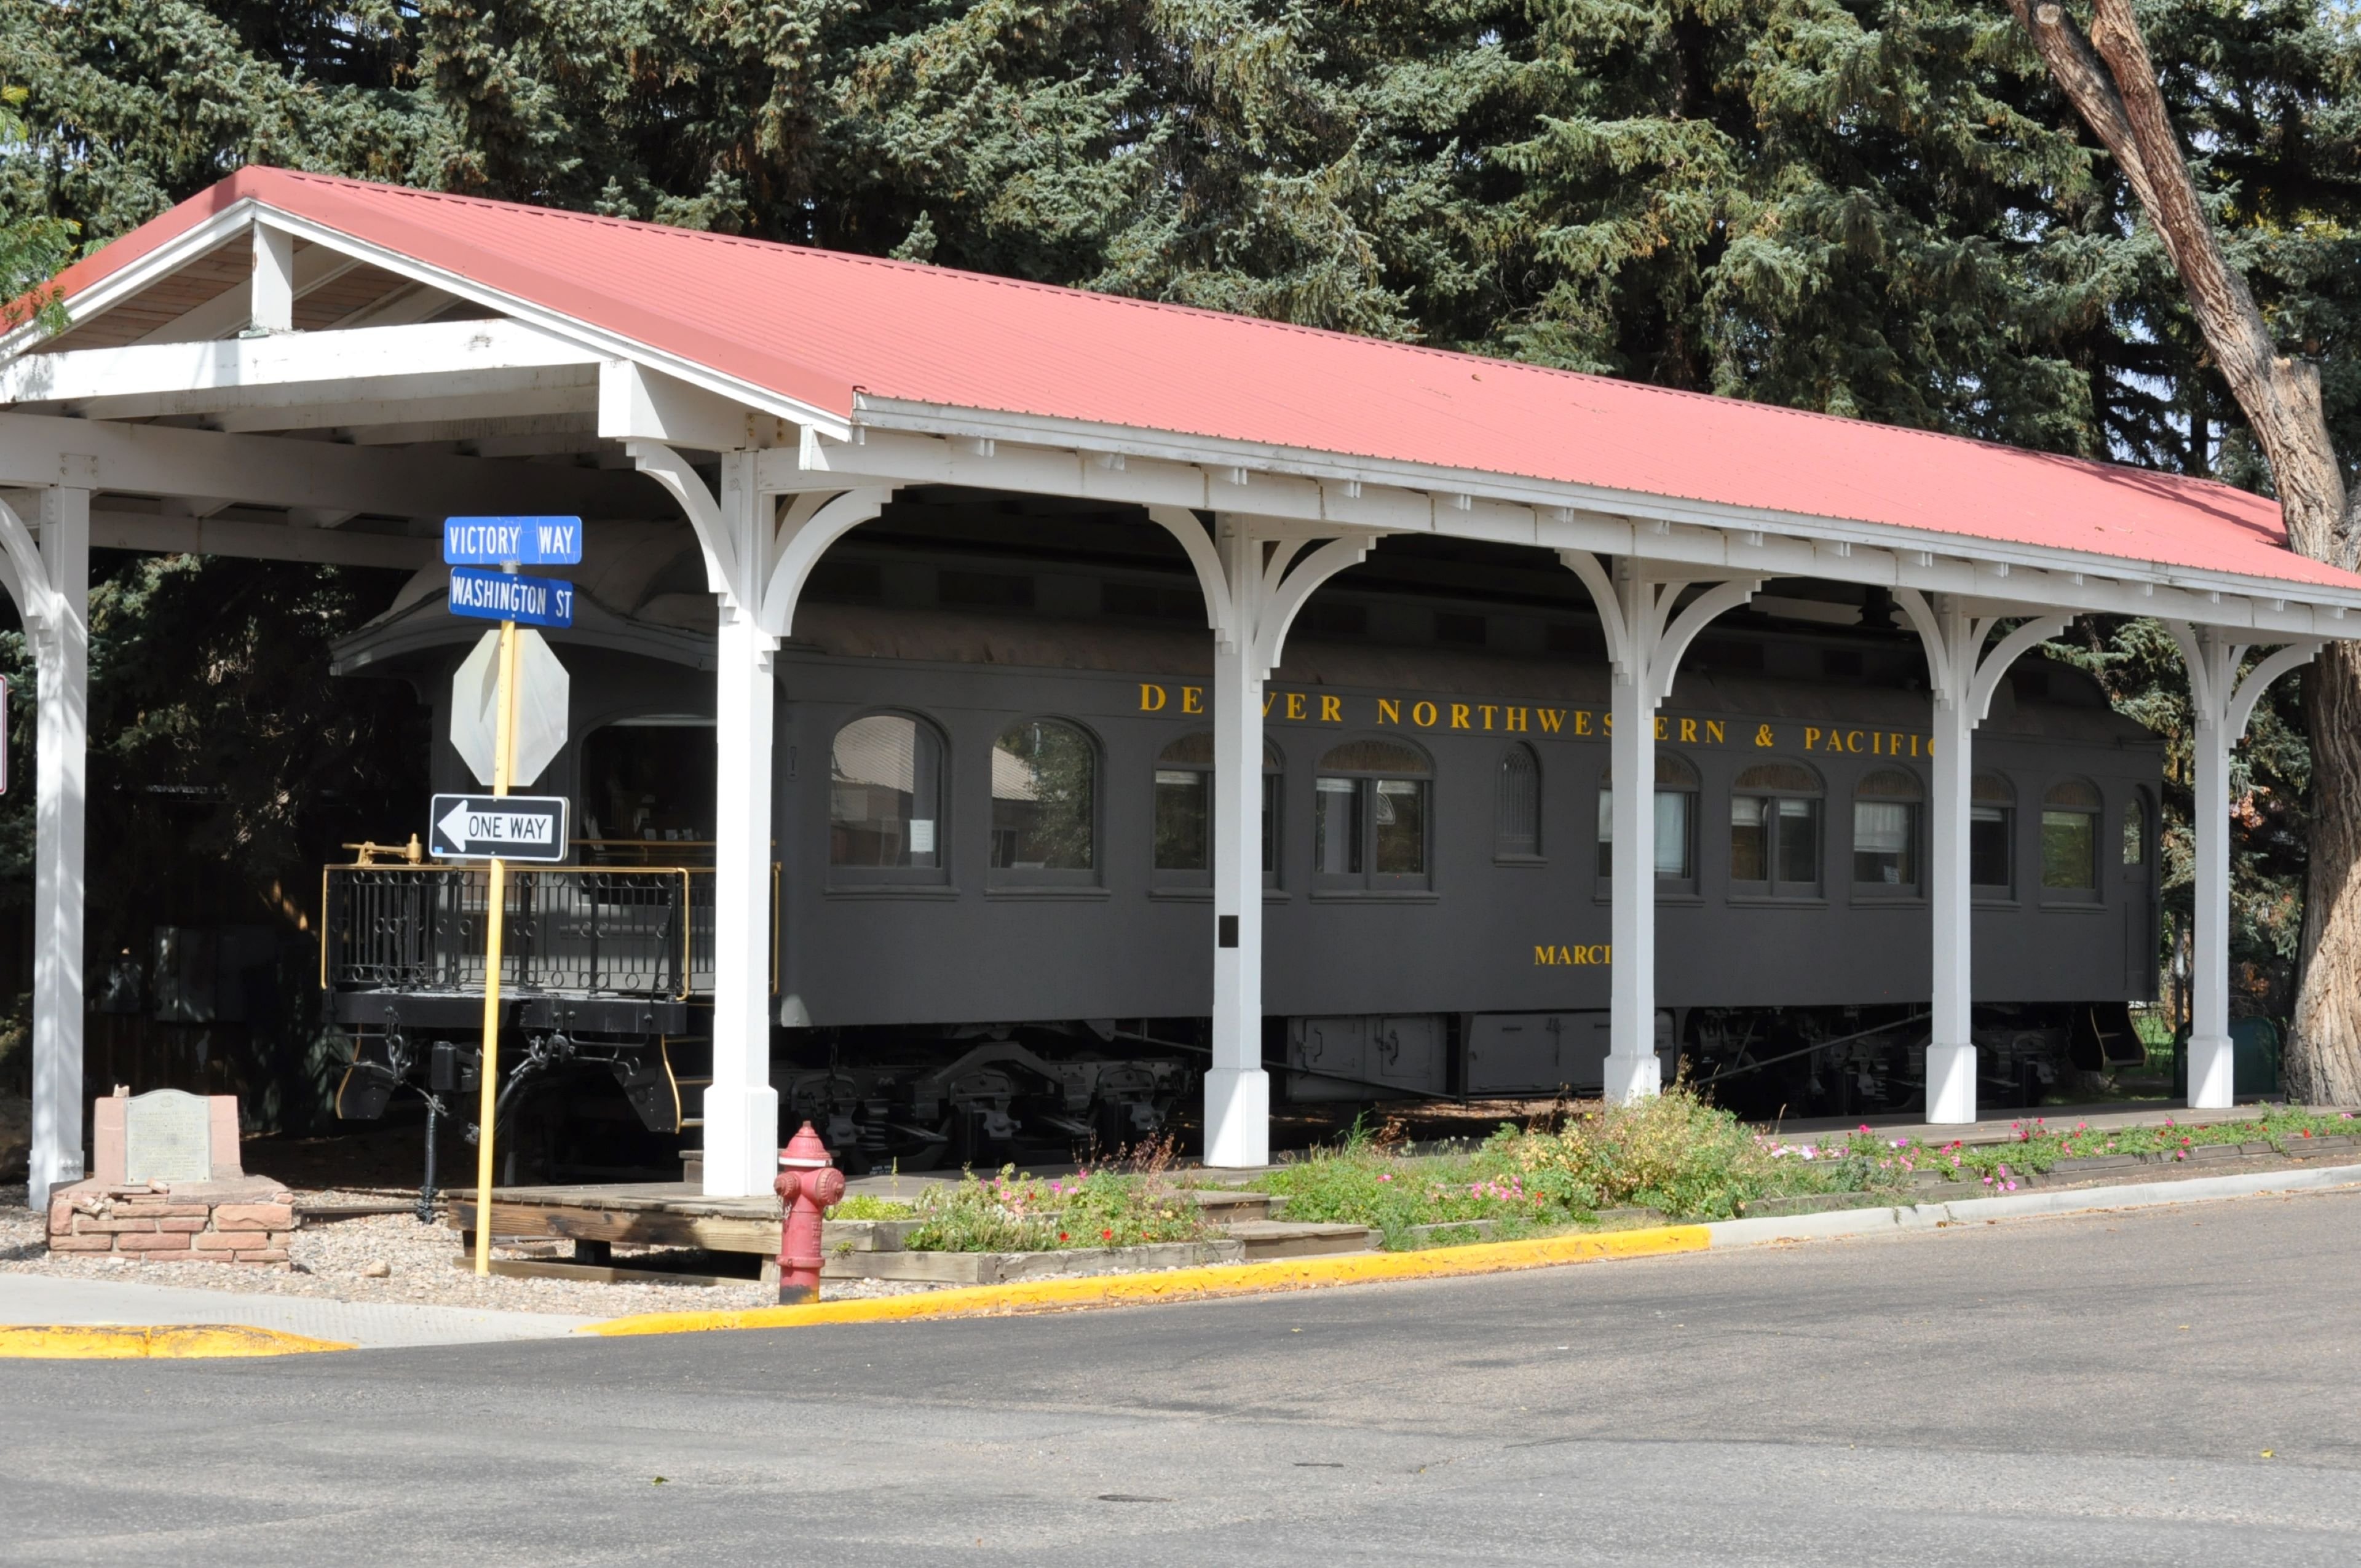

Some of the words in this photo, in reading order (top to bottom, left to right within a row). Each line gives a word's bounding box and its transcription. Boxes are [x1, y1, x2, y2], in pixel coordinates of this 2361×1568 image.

[449, 526, 520, 554] VICTORY
[539, 526, 574, 554] WAY
[452, 576, 546, 615] WASHINGTON
[556, 590, 572, 619] ST
[1139, 683, 1343, 722] DEVER
[1377, 699, 1726, 743] NORTHWESERN
[1754, 724, 1774, 748] &
[469, 815, 502, 838] ONE
[510, 817, 547, 839] WAY
[1534, 944, 1613, 965] MARCI
